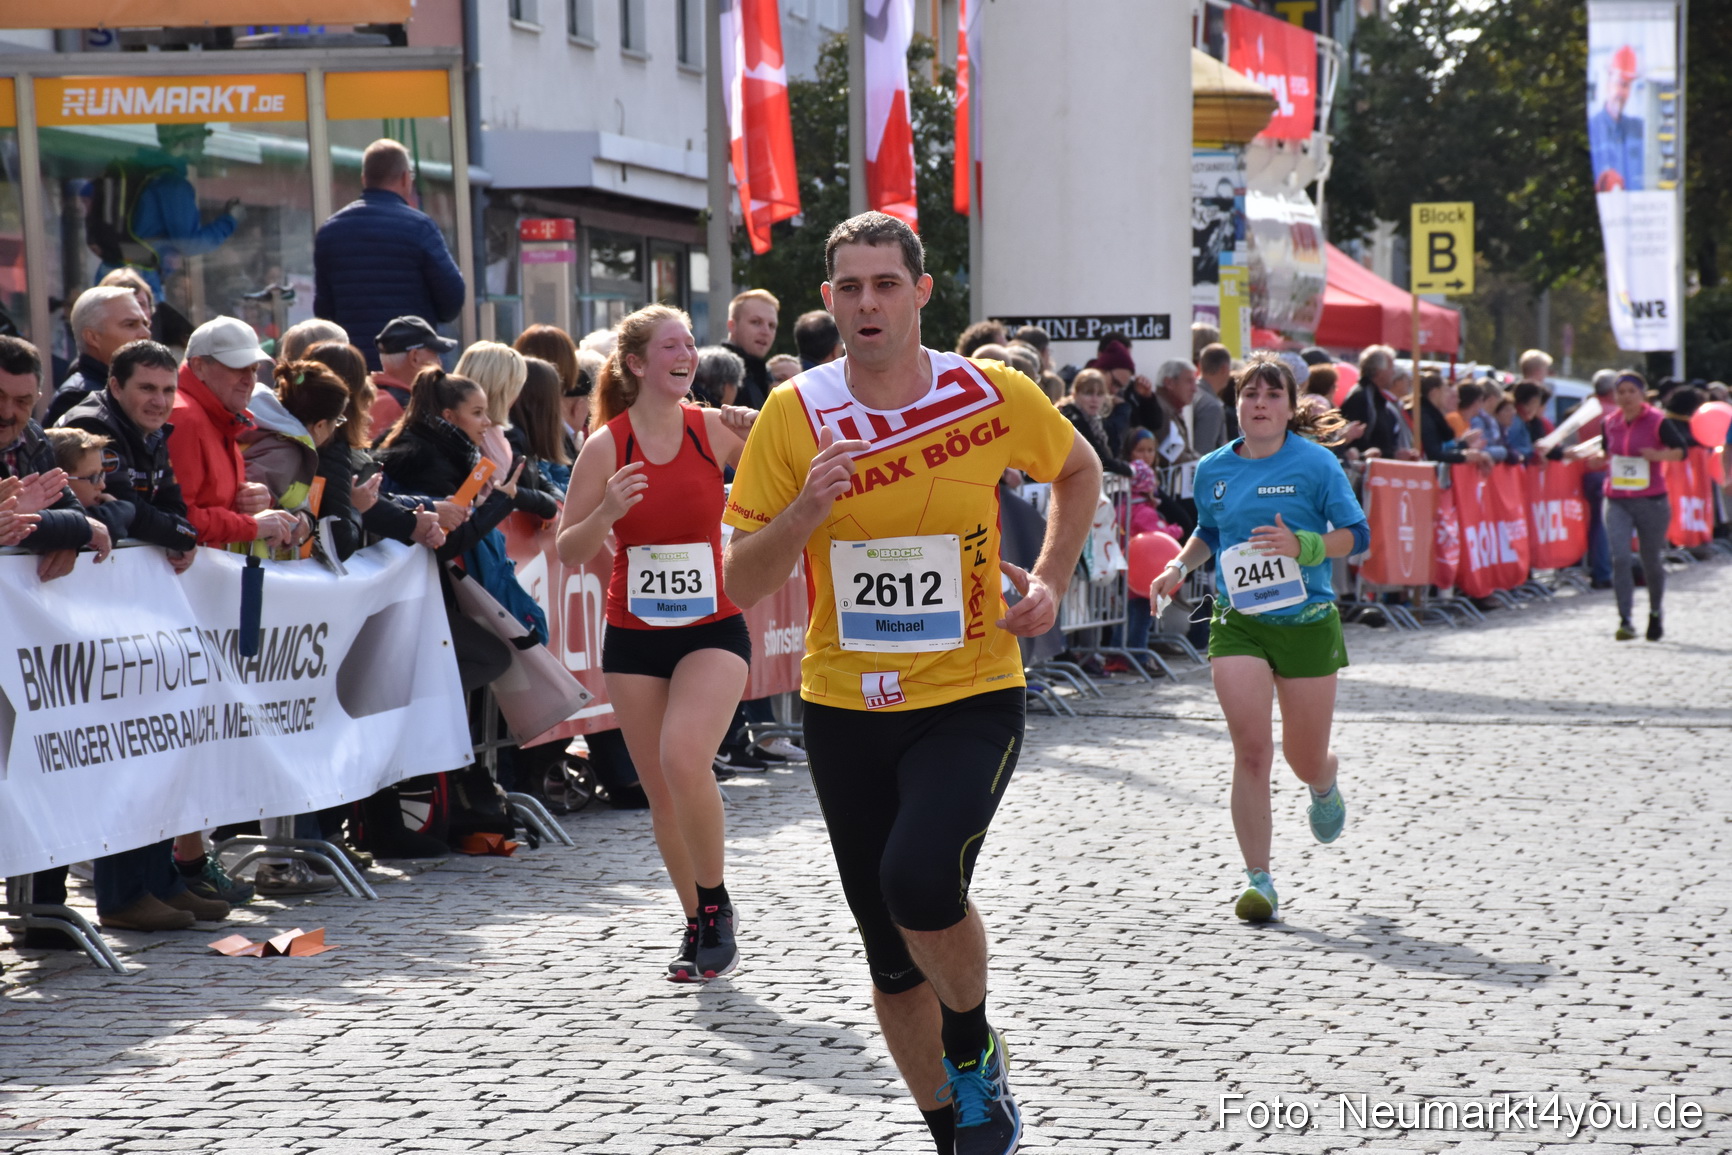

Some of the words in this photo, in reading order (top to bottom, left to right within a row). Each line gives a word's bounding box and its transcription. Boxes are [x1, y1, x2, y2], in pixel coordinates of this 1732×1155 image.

[61, 85, 285, 116] RUNMARKT.DE
[1419, 208, 1467, 224] Block
[1428, 231, 1457, 274] B
[921, 416, 1010, 469] BÖGL
[1257, 485, 1296, 495] BOCK
[879, 547, 923, 558] BOCK
[639, 569, 703, 594] 2153
[1234, 557, 1286, 588] 2441
[853, 571, 943, 607] 2612
[1254, 589, 1280, 600] Sophie
[656, 602, 688, 612] Marina
[875, 619, 925, 633] Michael
[16, 640, 96, 712] BMW
[34, 724, 114, 774] WENIGER
[110, 704, 218, 759] VERBRAUCH.
